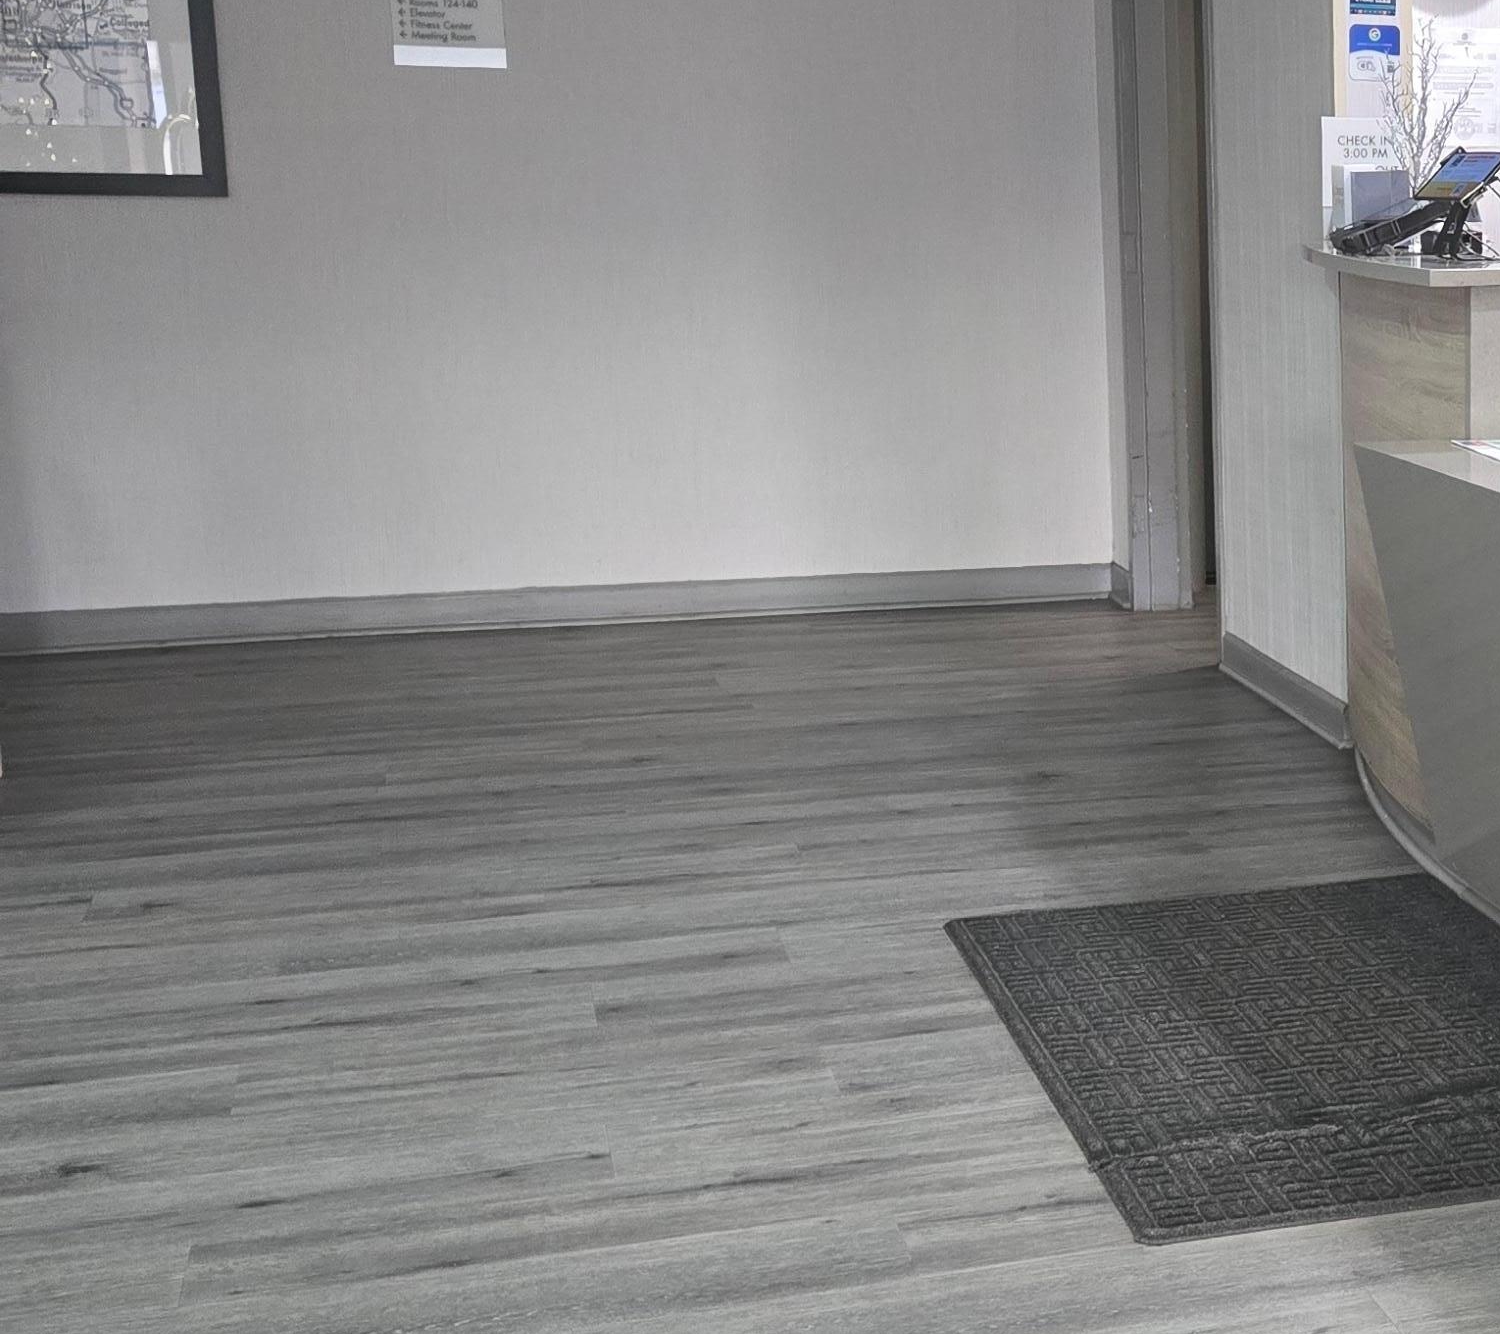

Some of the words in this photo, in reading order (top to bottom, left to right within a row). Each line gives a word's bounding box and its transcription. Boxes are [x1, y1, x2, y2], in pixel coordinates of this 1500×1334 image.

[443, 20, 473, 31] Center
[411, 31, 448, 44] Meeting
[450, 32, 477, 42] Room
[1337, 135, 1376, 146] CHECK
[1343, 148, 1368, 159] 3:00
[1371, 148, 1389, 159] PM
